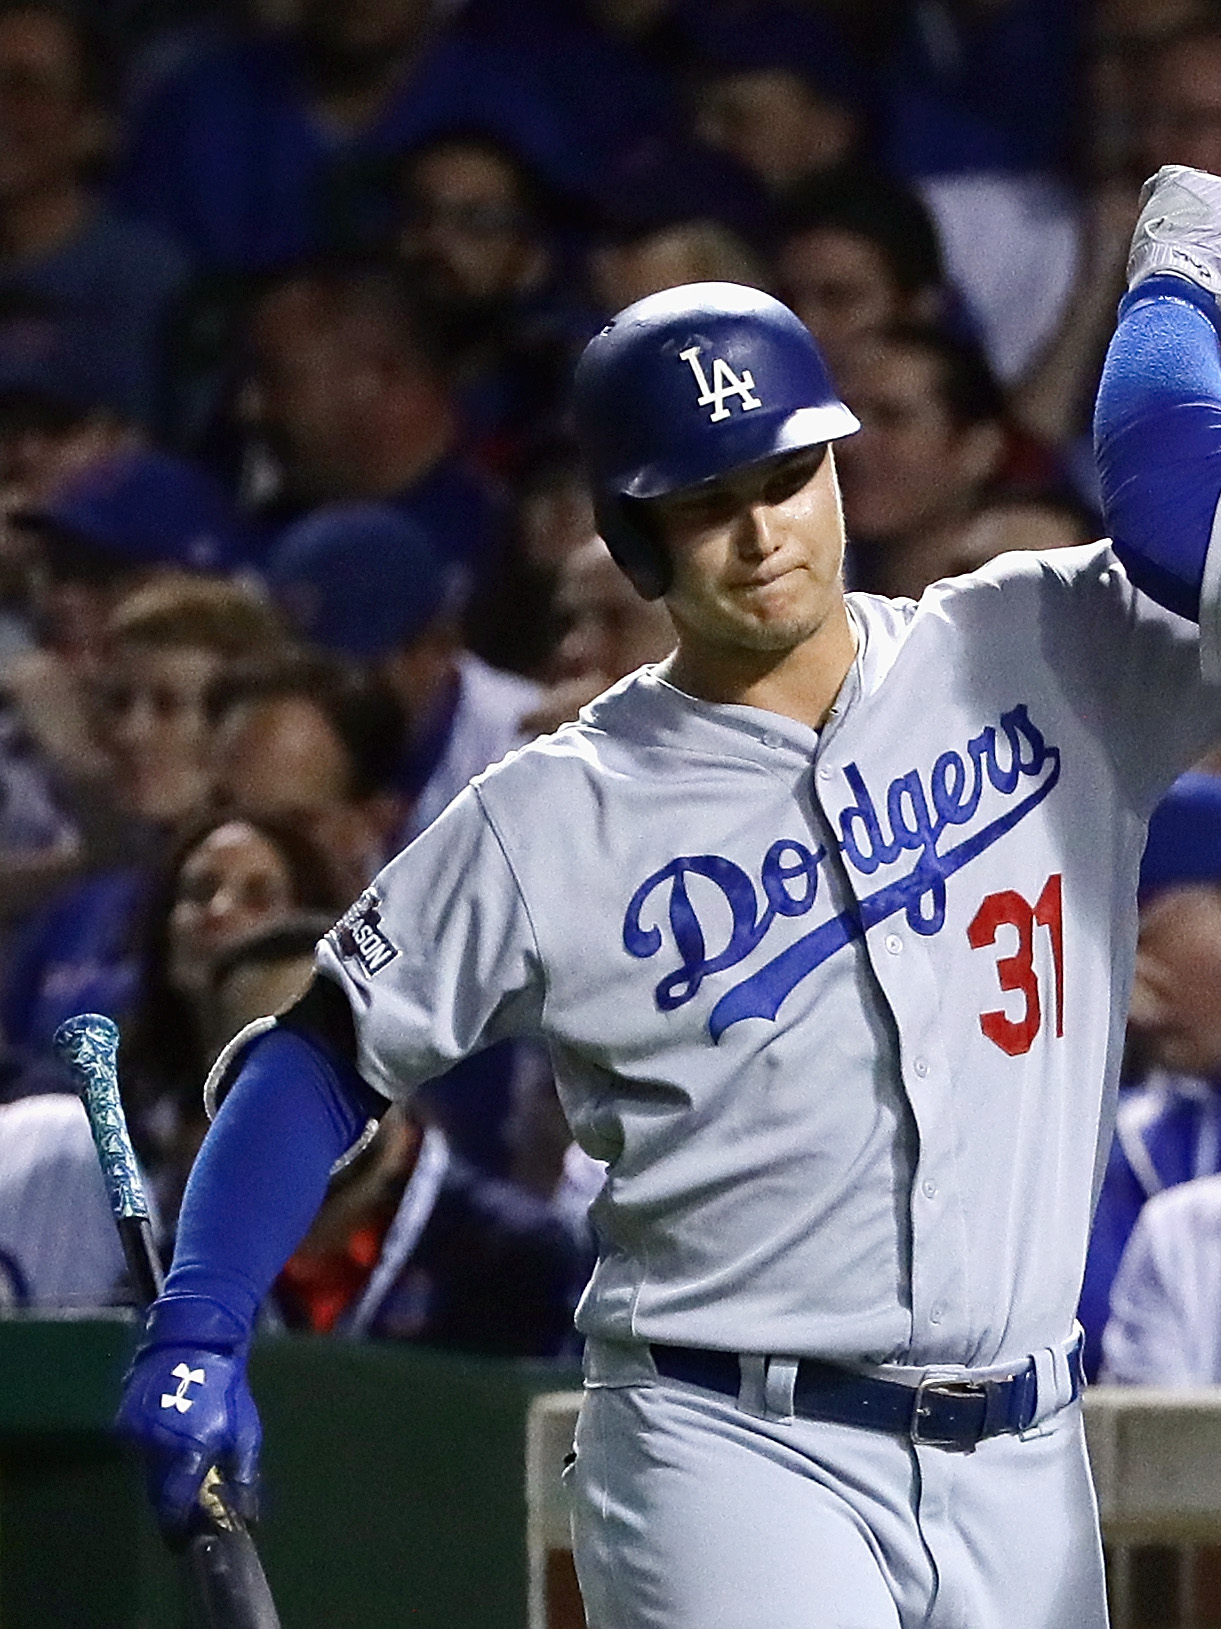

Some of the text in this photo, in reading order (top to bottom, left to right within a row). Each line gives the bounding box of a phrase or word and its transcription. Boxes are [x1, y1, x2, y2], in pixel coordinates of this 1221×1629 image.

[679, 346, 762, 422] LA
[623, 703, 1061, 1012] Dodgers
[967, 873, 1064, 1057] 31
